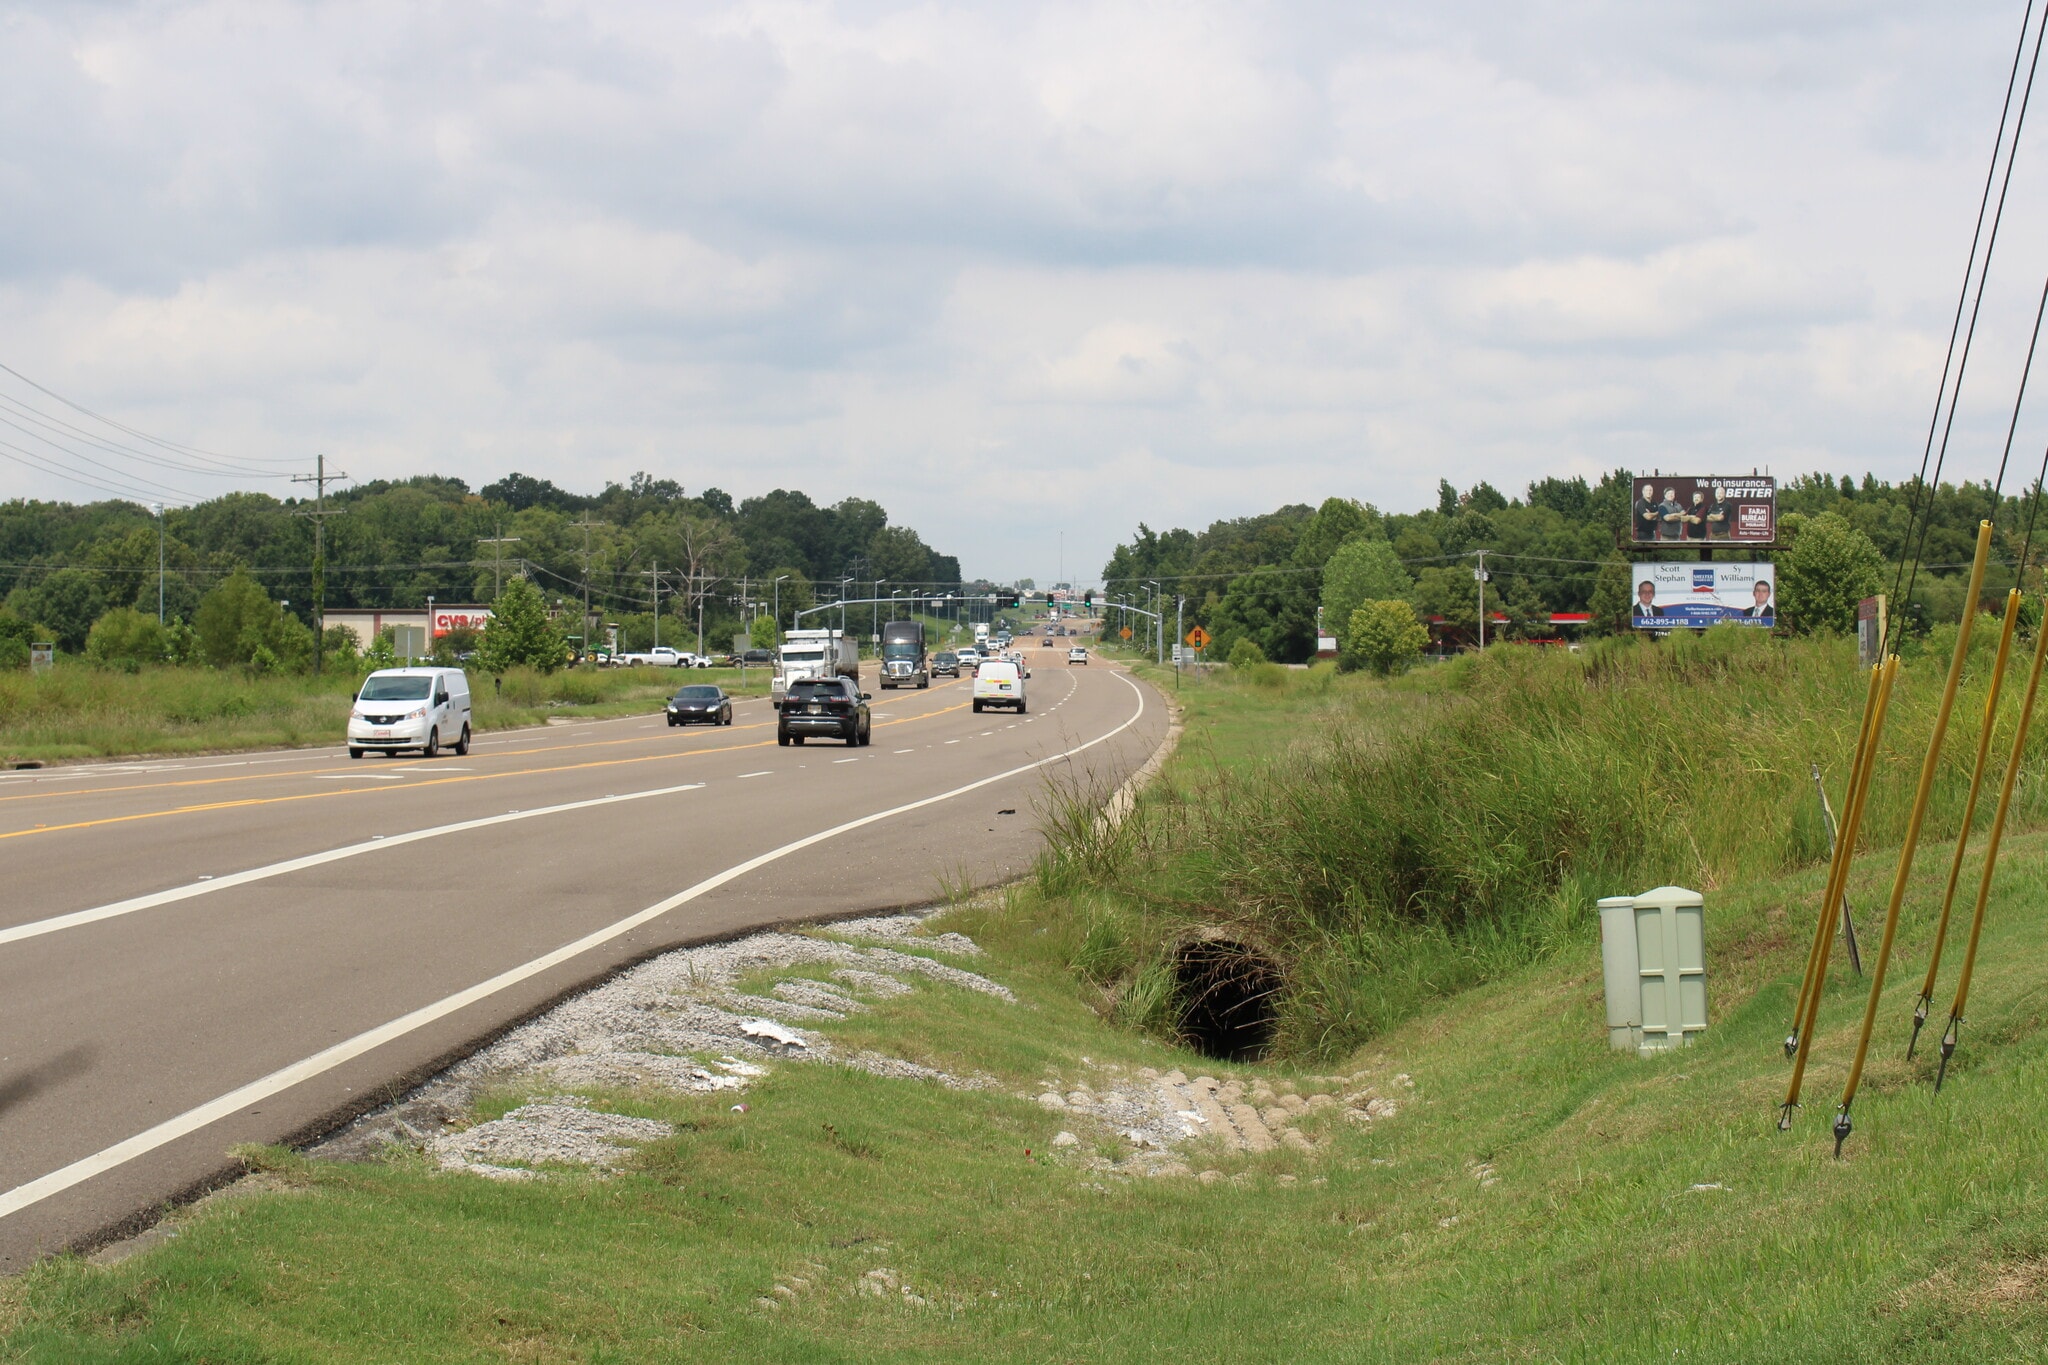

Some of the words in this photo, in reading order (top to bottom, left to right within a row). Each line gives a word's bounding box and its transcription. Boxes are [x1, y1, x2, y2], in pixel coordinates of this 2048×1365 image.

[1696, 479, 1709, 488] We
[1712, 479, 1722, 488] do
[1723, 479, 1772, 488] insurance...
[1726, 488, 1772, 498] BETTER
